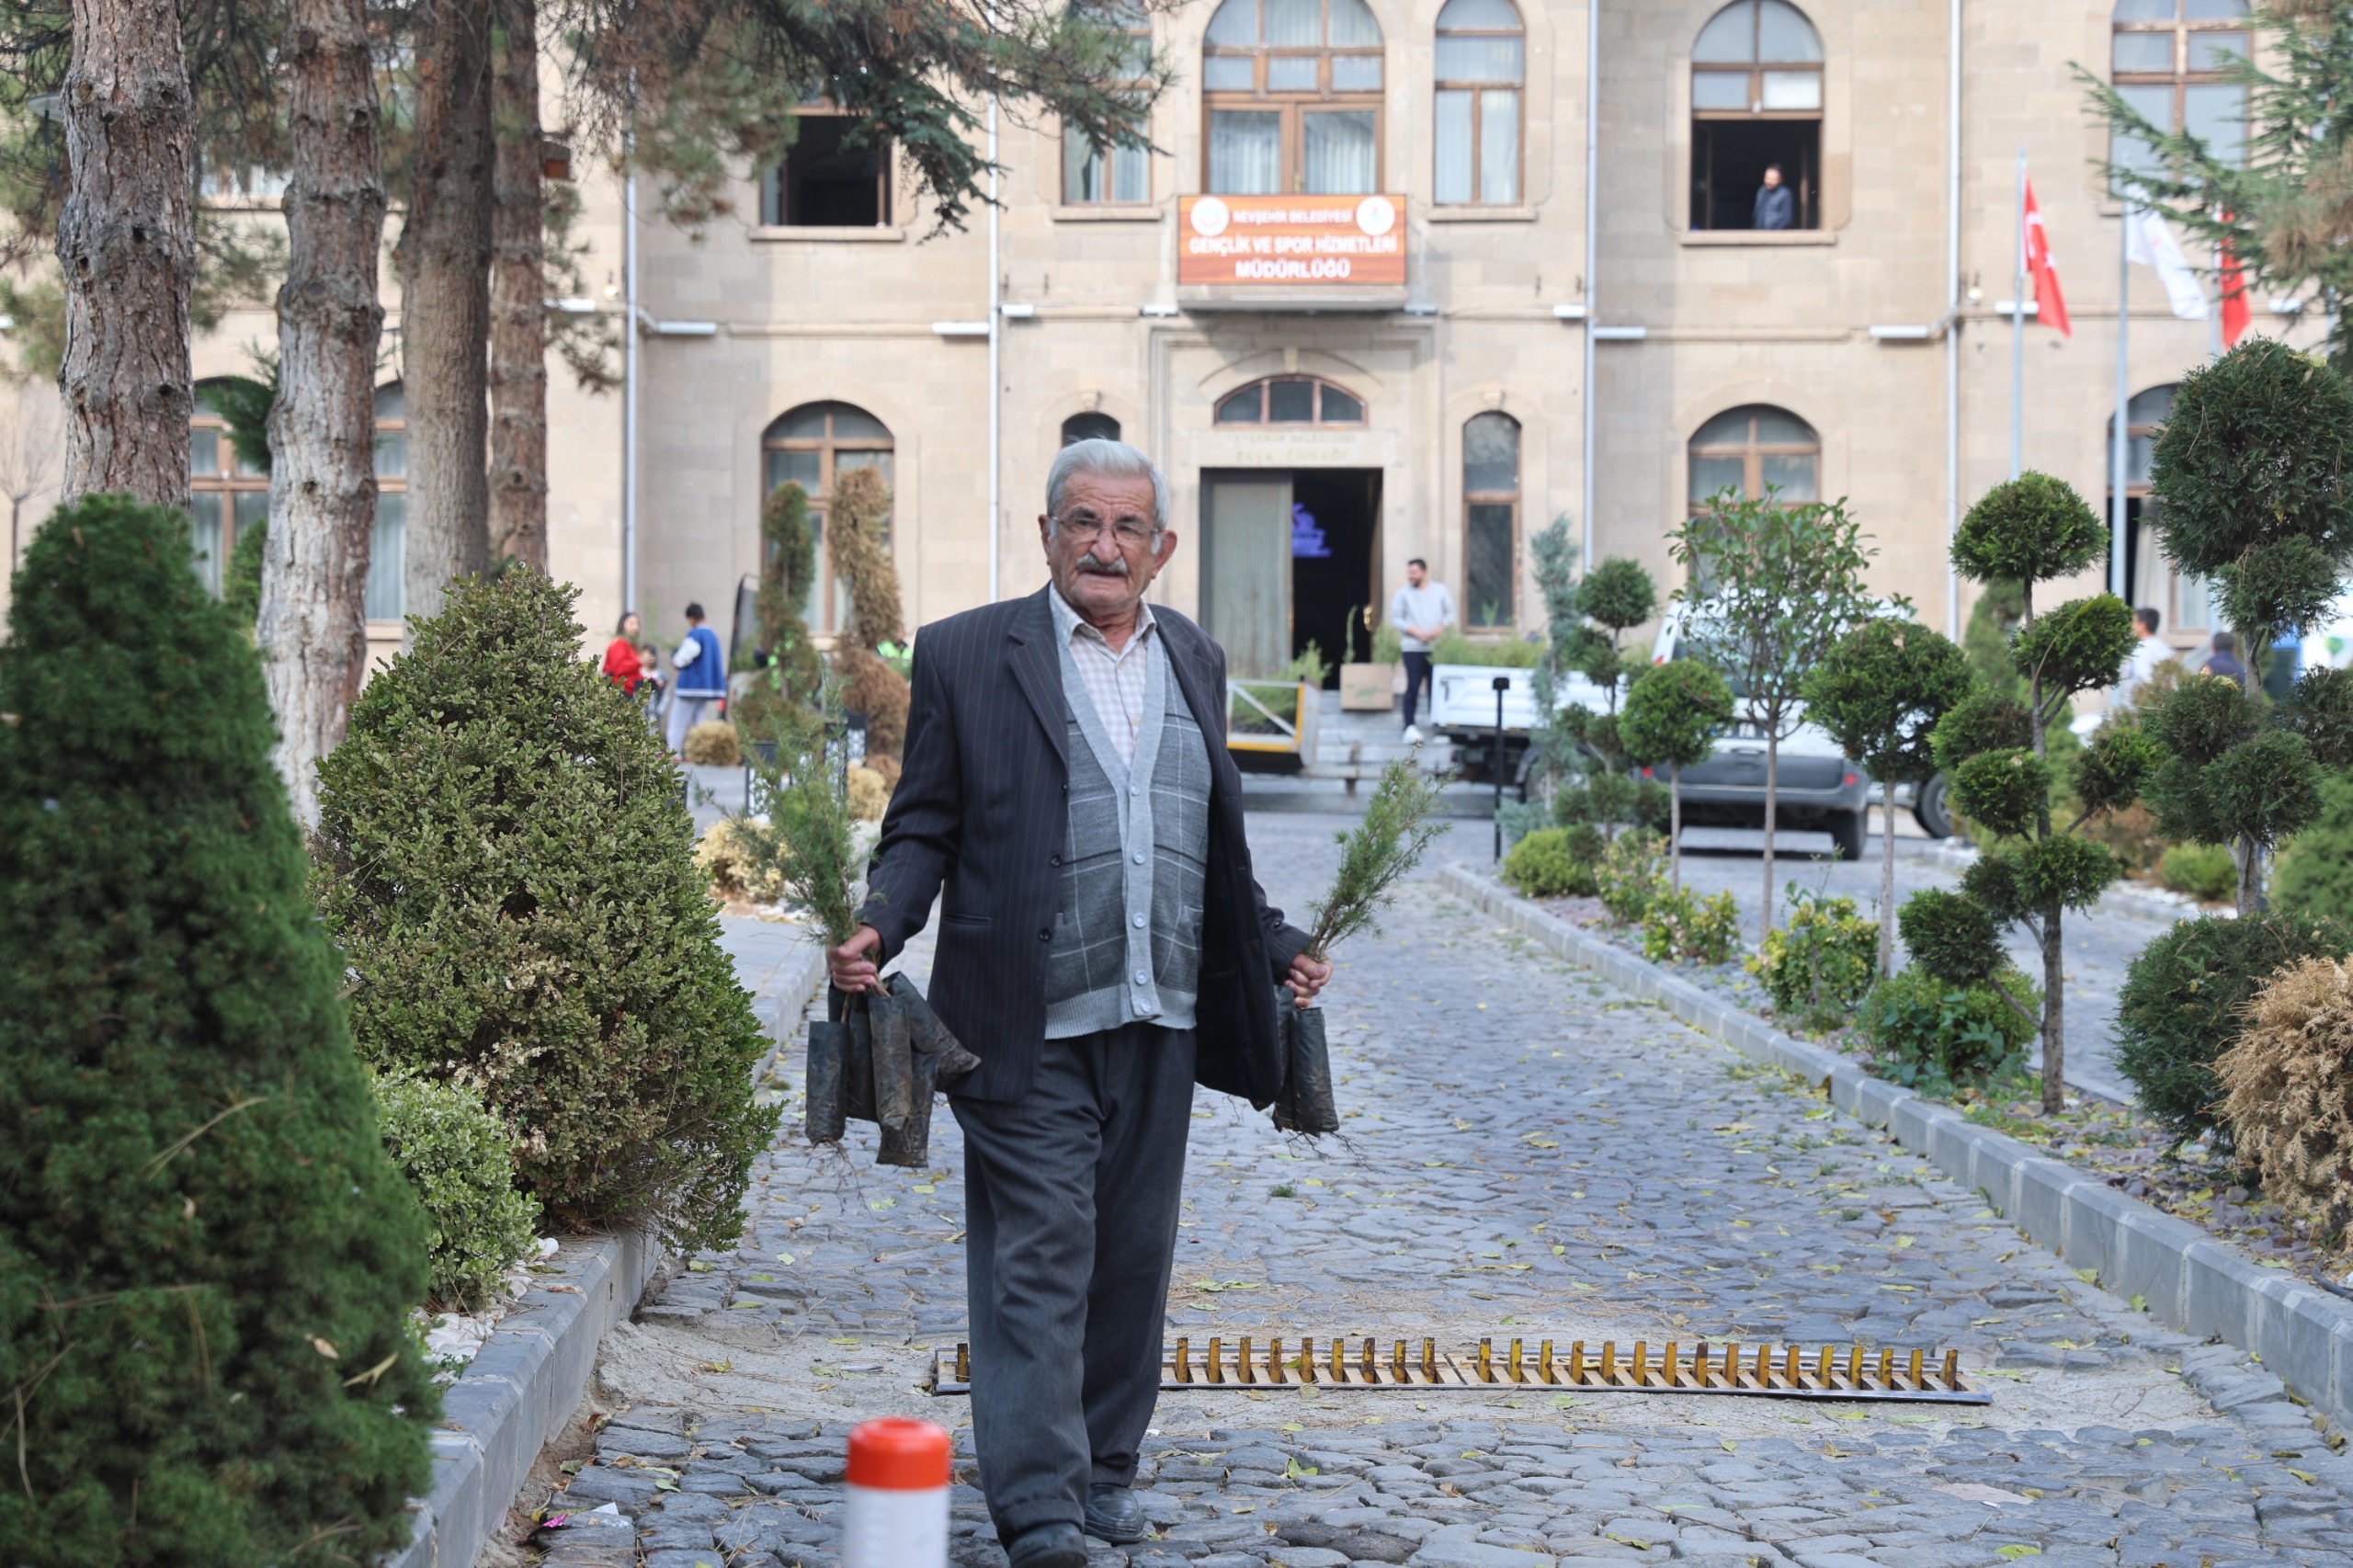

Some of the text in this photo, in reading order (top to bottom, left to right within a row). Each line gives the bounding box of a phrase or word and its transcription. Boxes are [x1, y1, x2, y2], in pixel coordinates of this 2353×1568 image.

[1188, 233, 1397, 256] GENÇLİK VE SPOR HİZMETLERİ
[1235, 257, 1350, 278] MÜDÜRLÜĞÜ
